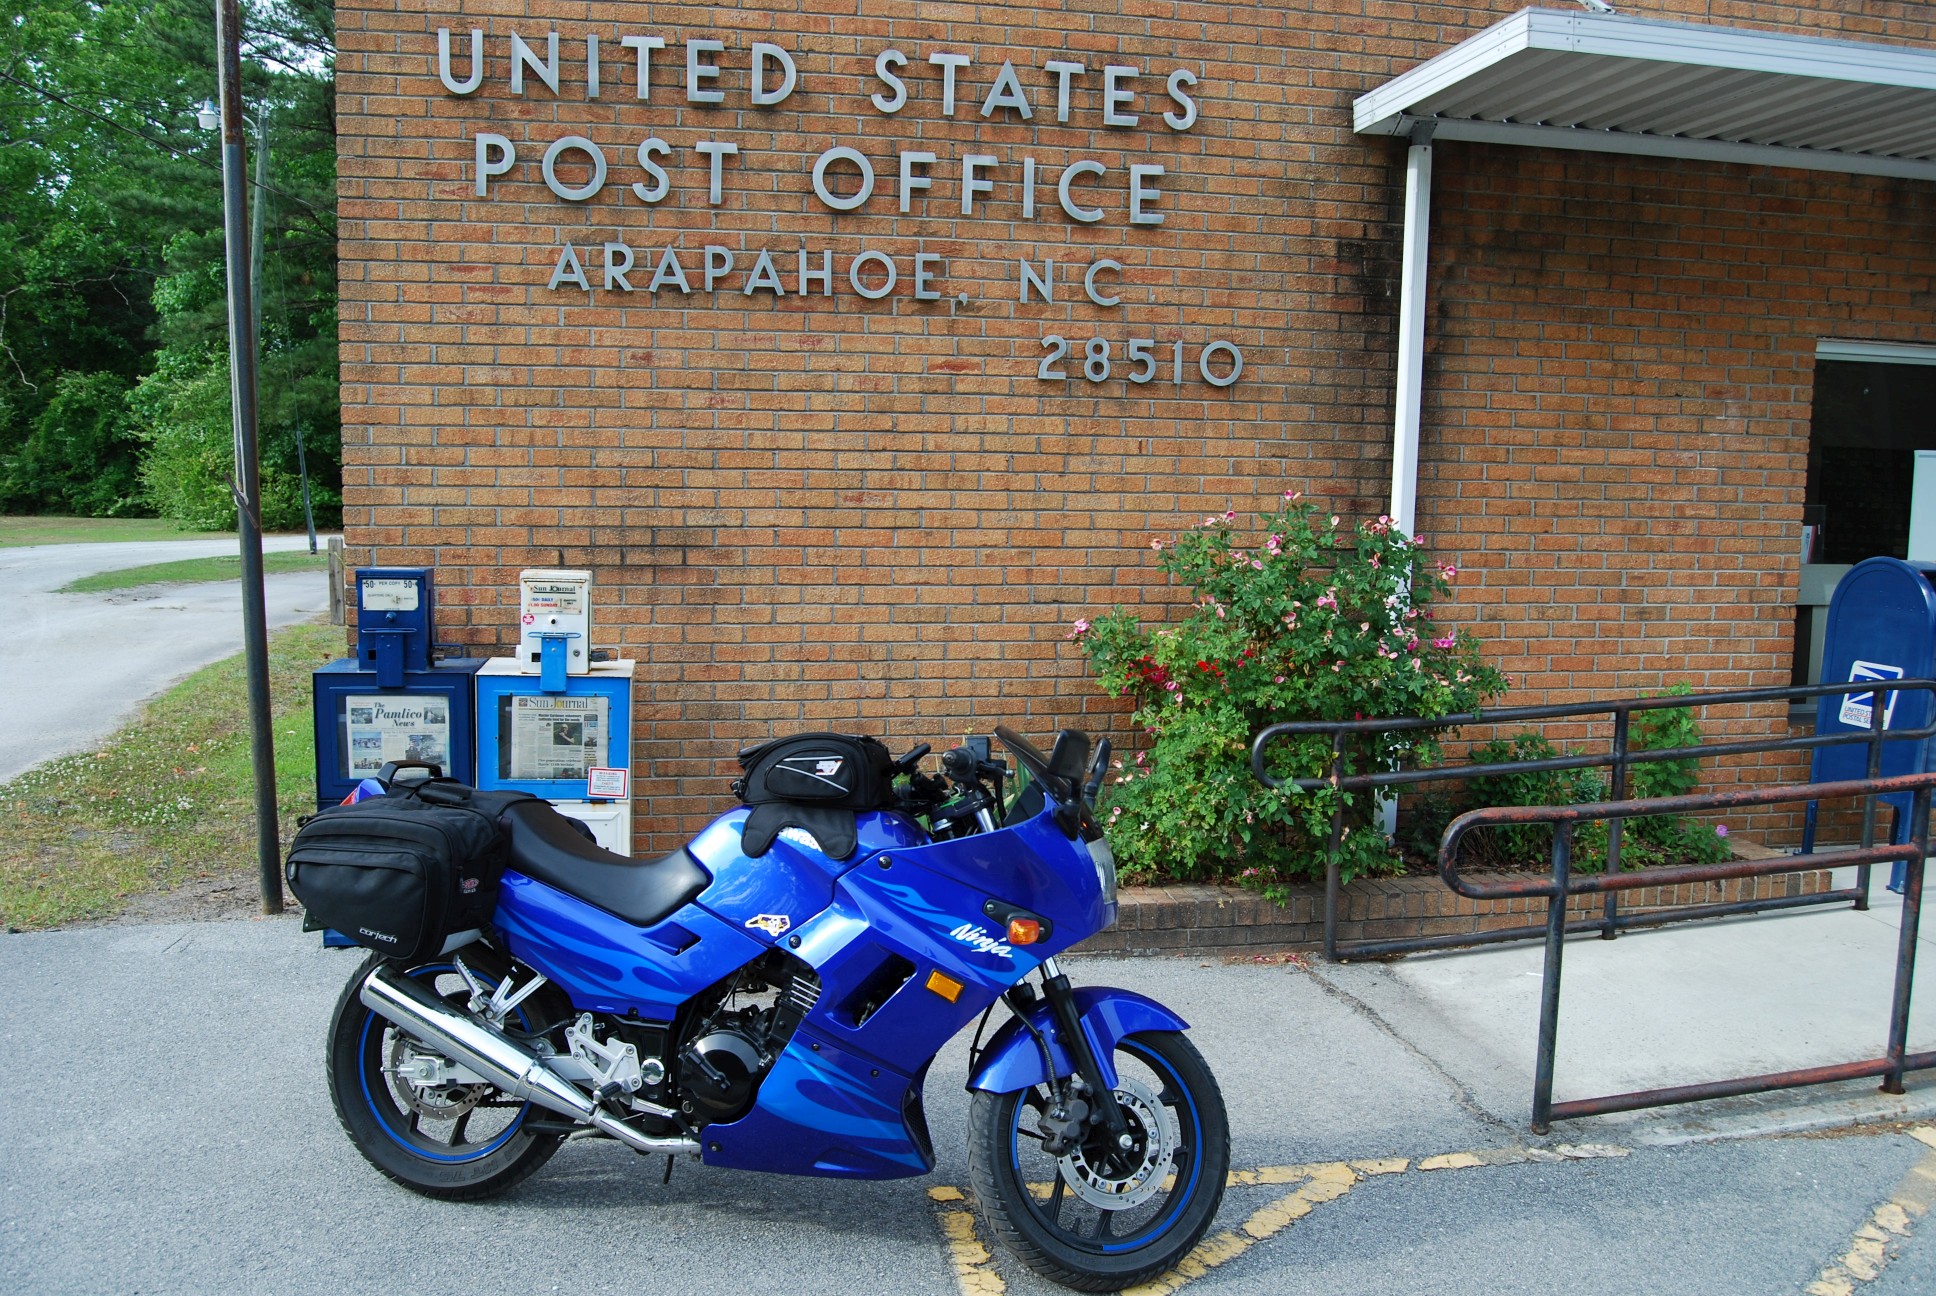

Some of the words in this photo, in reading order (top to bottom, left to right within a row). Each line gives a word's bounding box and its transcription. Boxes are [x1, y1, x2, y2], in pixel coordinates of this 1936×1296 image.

[437, 27, 797, 105] UNITED
[871, 48, 1198, 132] STATES
[474, 132, 739, 206] POST
[811, 146, 1166, 226] OFFICE
[546, 241, 970, 306] ARAPAHOE,
[1037, 334, 1245, 388] 28510
[533, 584, 547, 592] Sun
[549, 584, 576, 592] Journal
[529, 696, 549, 709] Sun
[550, 696, 588, 709] Journal
[374, 707, 423, 720] Pamlico
[1844, 706, 1866, 715] UNITED
[392, 719, 415, 728] News
[1843, 714, 1862, 723] POSTAL
[359, 926, 398, 944] cortech
[949, 923, 1013, 958] Ninja
